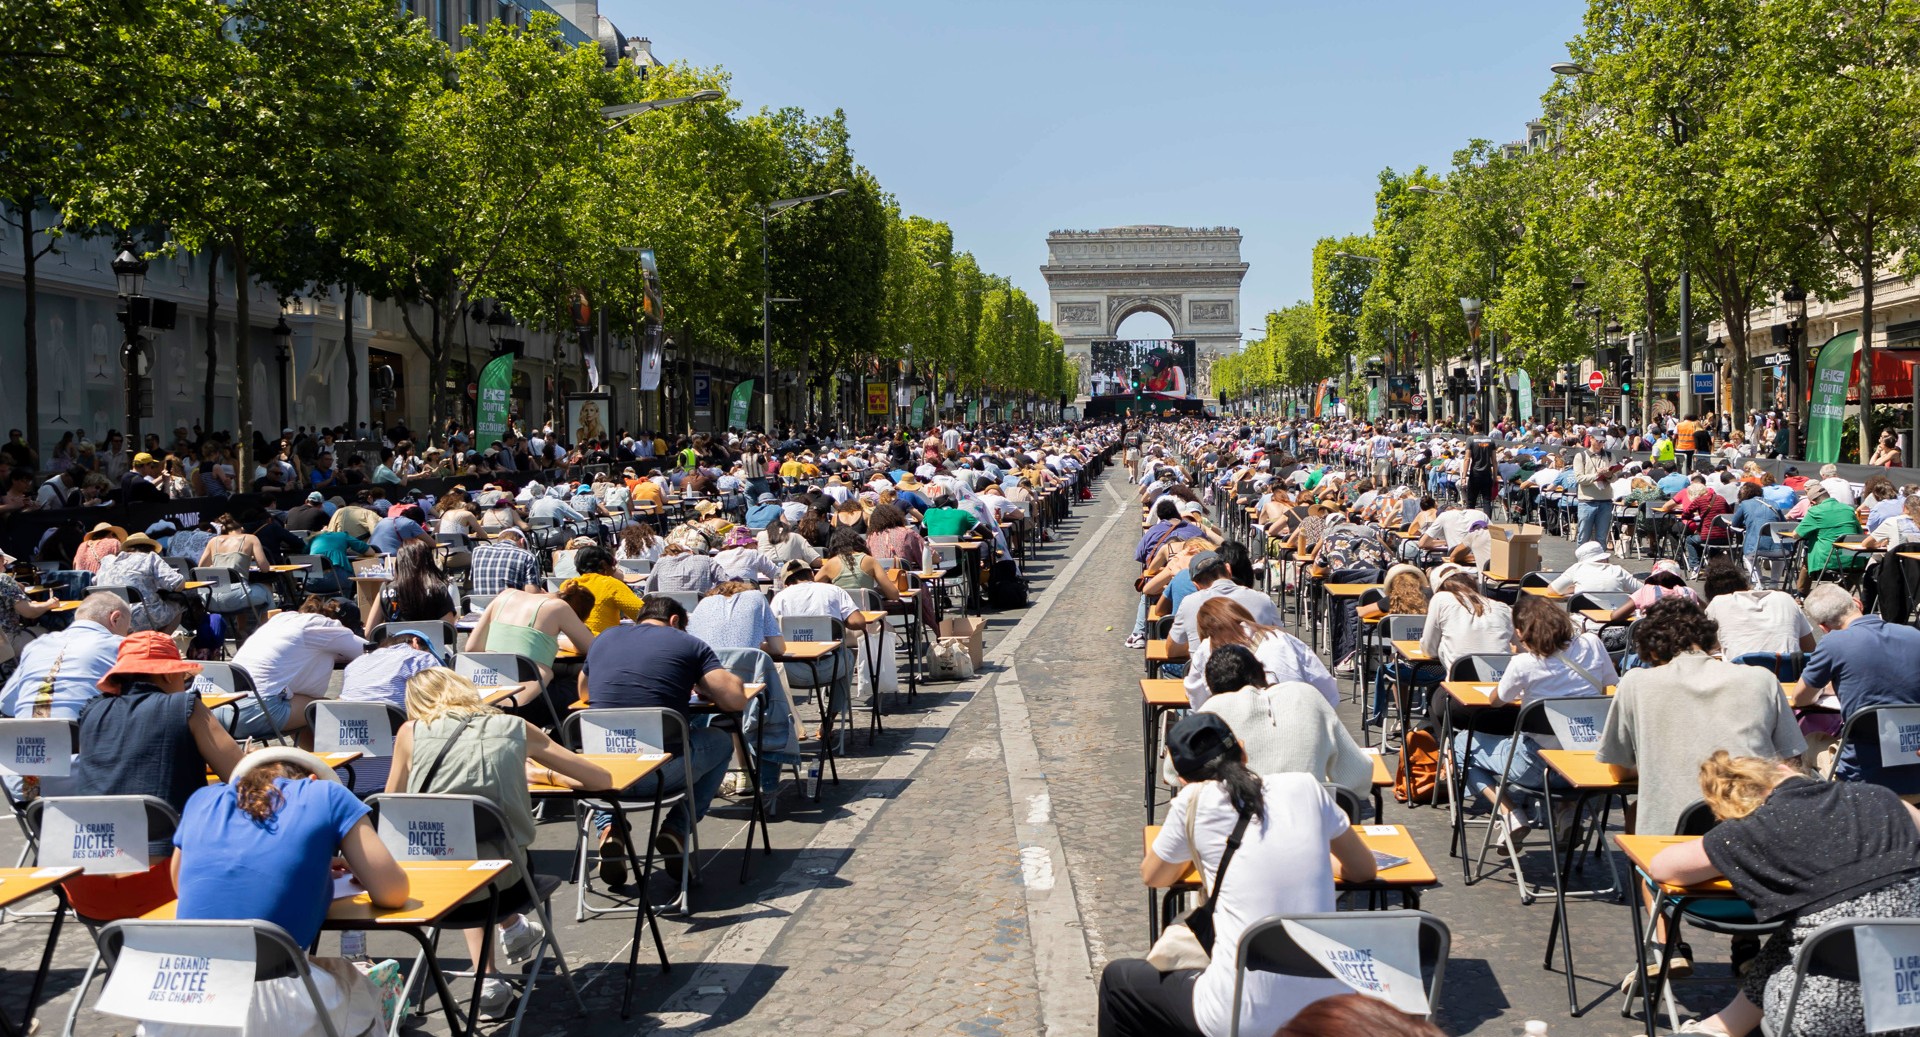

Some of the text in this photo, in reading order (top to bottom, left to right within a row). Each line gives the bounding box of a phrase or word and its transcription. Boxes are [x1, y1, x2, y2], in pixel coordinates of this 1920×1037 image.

[696, 380, 707, 394] P
[1819, 383, 1843, 394] SORTIE
[1823, 395, 1833, 403] DE
[482, 402, 504, 412] SORTIE
[1813, 404, 1843, 416] SECOURS
[487, 413, 495, 421] DE
[479, 423, 506, 432] SECOURS
[793, 634, 813, 642] DICTÉE
[473, 674, 498, 684] DICTÉE
[340, 727, 369, 739] DICTÉE
[1569, 724, 1596, 736] DICTÉE
[1905, 724, 1920, 732] GRAN
[16, 736, 46, 745] LA GRANDE
[606, 736, 637, 747] DICTÉE
[16, 745, 46, 757] DICTÉE
[75, 823, 115, 833] LA GRANDE
[408, 821, 445, 831] LA GRANDE
[74, 833, 115, 849] DICTÉE
[408, 830, 446, 846] DICTÉE
[73, 850, 86, 858] DES
[408, 847, 420, 855] DES
[1325, 949, 1373, 961] LA GRANDE
[159, 957, 211, 970] LA GRANDE
[1894, 957, 1905, 970] LA
[1332, 961, 1378, 981] DICTÉE
[153, 970, 208, 991] DICTÉE
[1895, 971, 1920, 992] DIC
[148, 991, 166, 1001] DES
[1897, 992, 1912, 1005] DES
